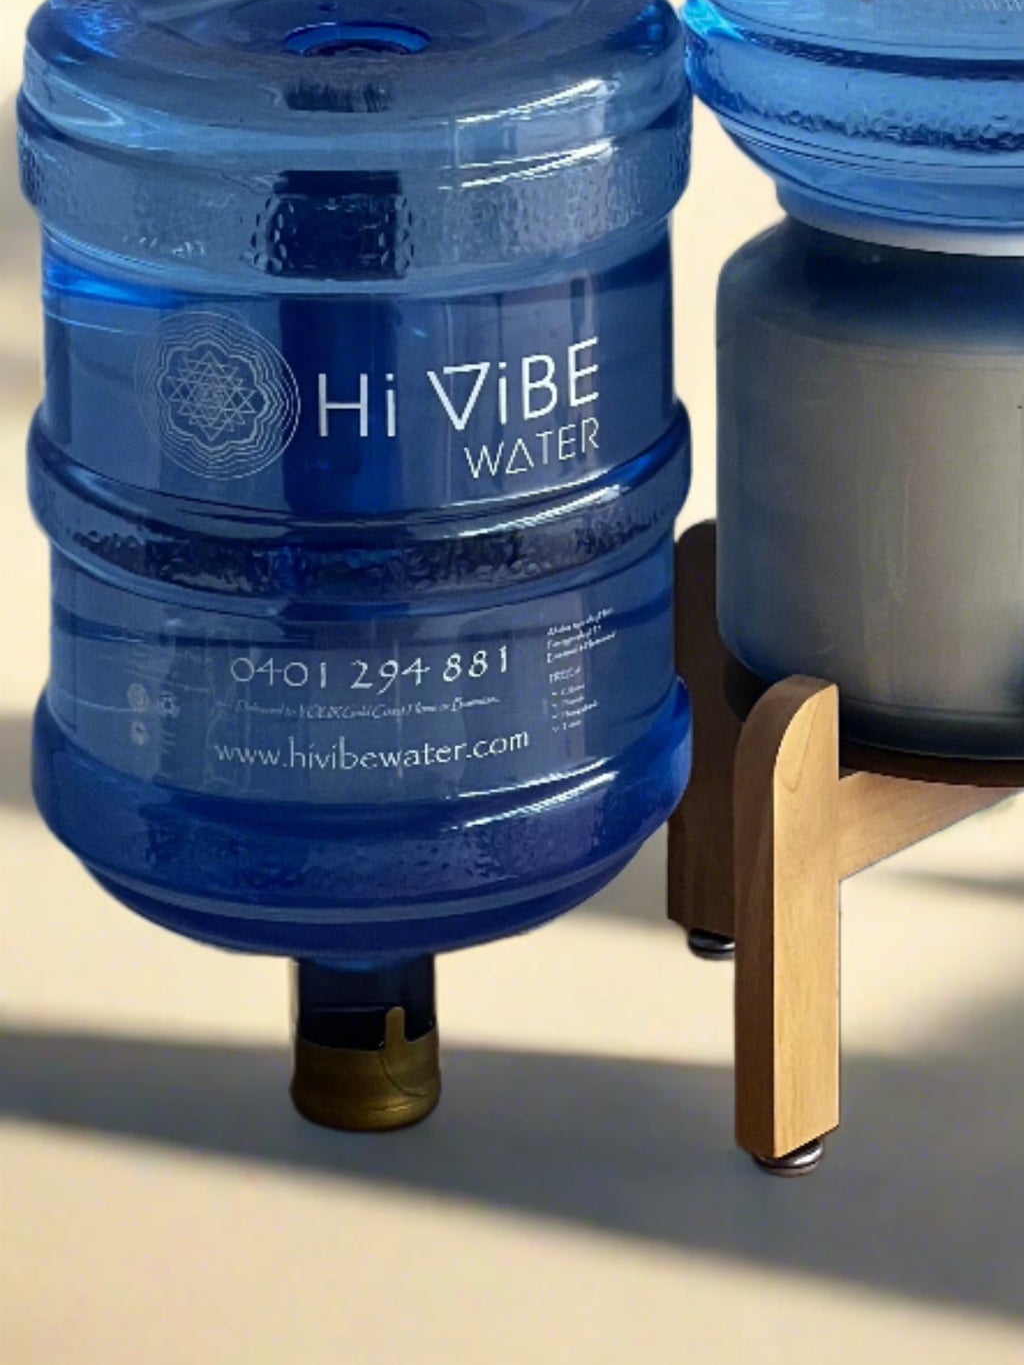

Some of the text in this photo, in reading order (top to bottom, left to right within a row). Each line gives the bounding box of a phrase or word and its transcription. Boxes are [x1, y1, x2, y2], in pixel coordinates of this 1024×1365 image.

[318, 372, 396, 437] Hi
[463, 416, 600, 479] WATER
[230, 644, 508, 696] 0401 294 881
[213, 730, 530, 771] www.hivibewater.com
